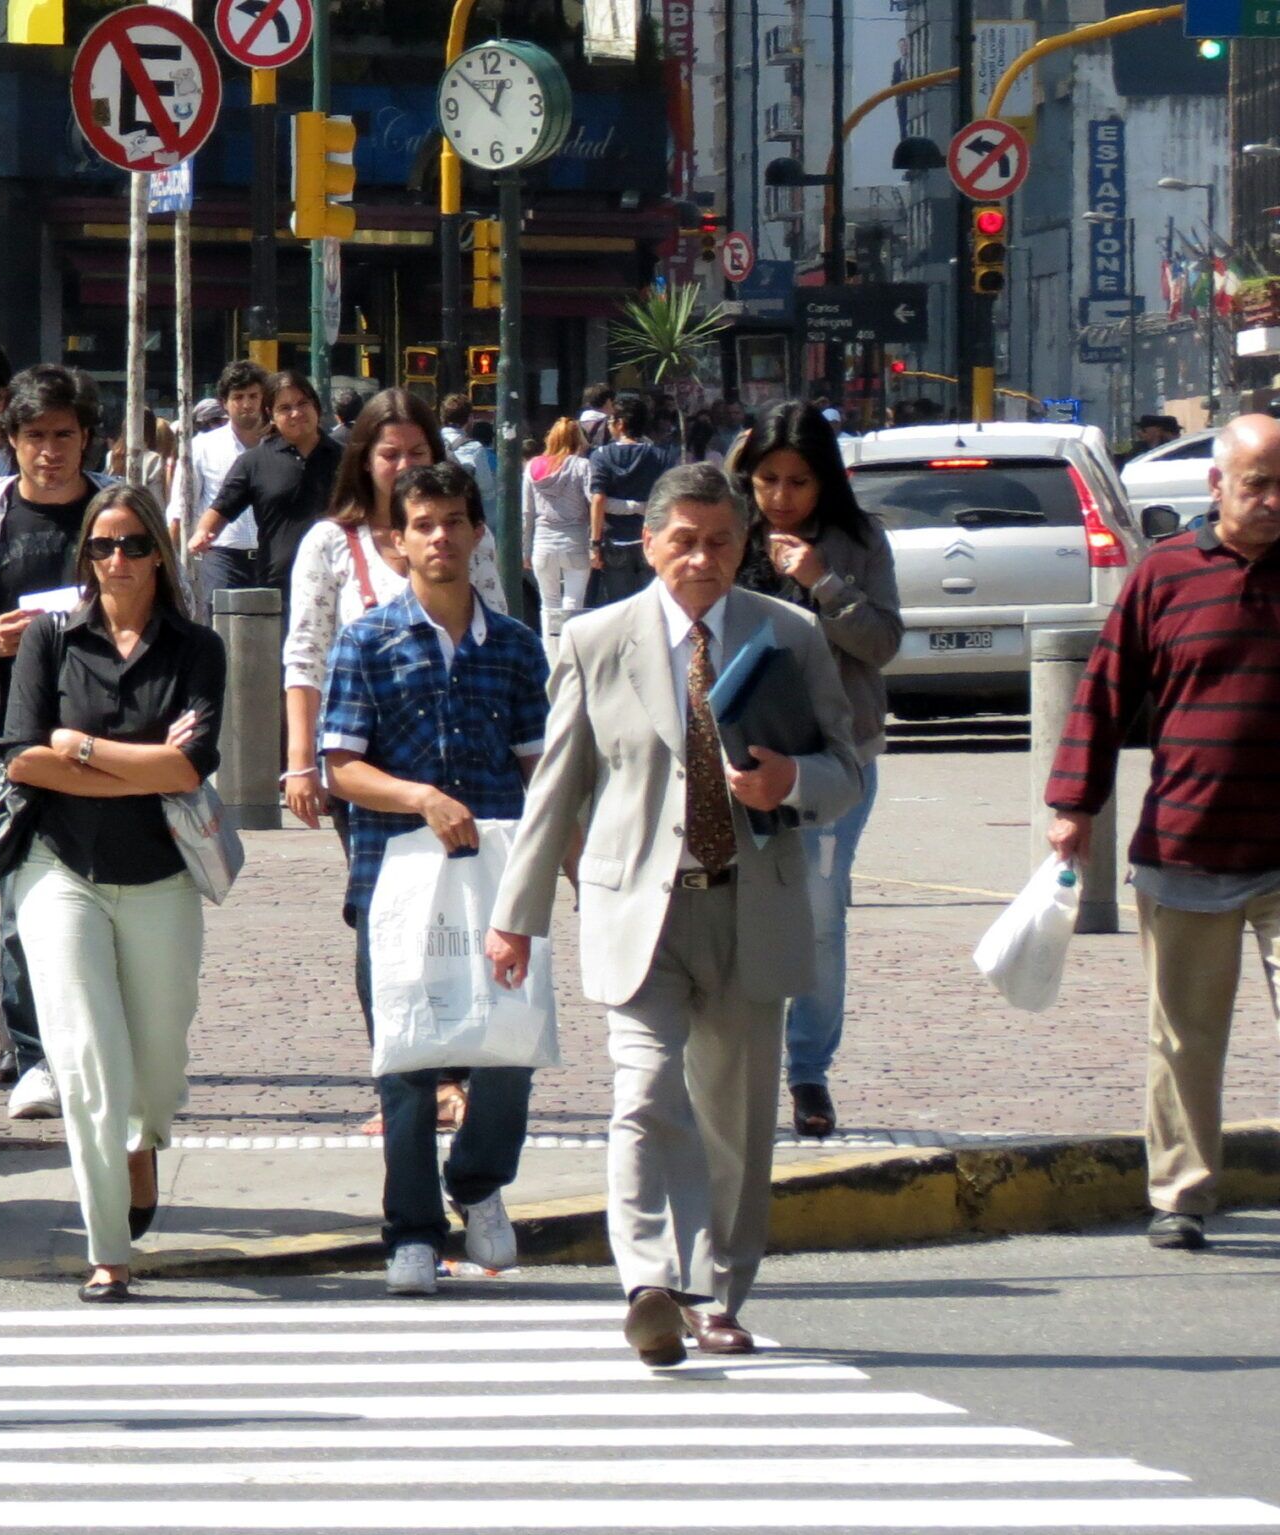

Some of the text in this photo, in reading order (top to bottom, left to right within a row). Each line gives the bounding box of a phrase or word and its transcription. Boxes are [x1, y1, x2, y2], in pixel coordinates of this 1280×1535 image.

[480, 51, 501, 75] 12
[445, 98, 459, 121] 9
[529, 94, 543, 117] 3
[490, 141, 504, 163] 6
[931, 631, 991, 650] JSJ 208
